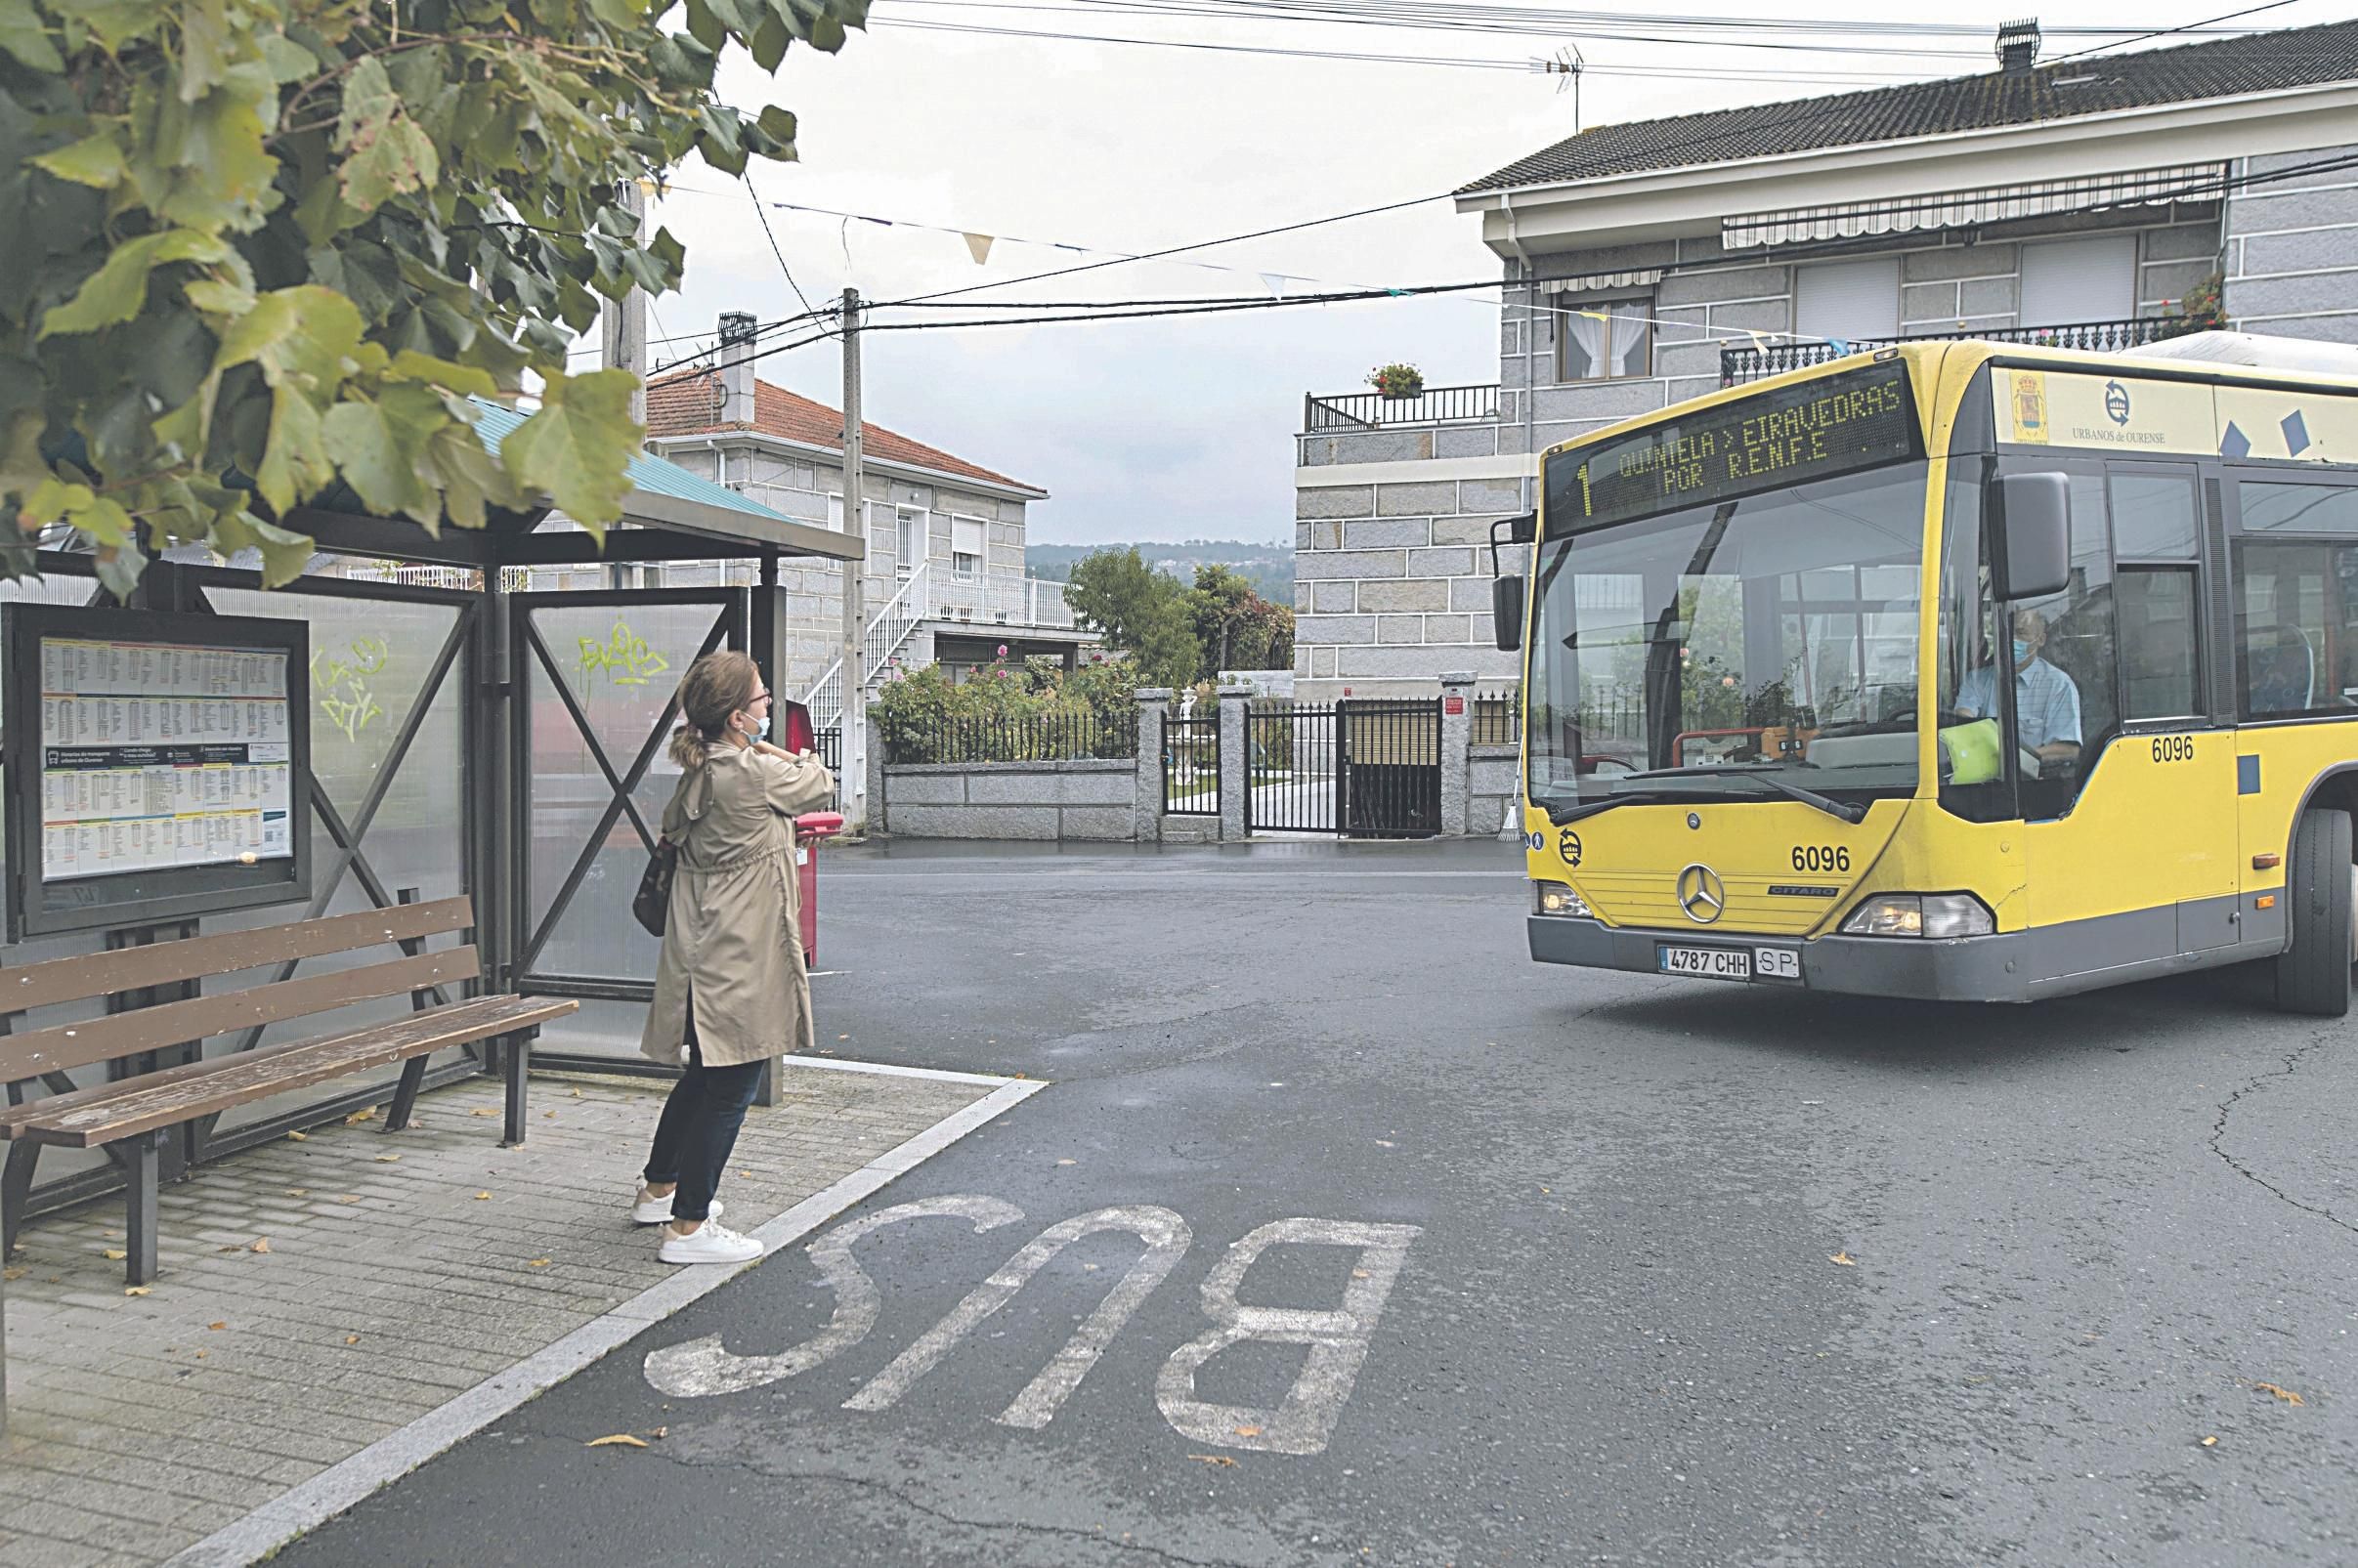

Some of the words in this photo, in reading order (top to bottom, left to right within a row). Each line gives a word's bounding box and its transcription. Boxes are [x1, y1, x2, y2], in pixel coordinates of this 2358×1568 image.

[1619, 432, 1715, 478] QUINTELA
[1742, 380, 1901, 446] EIRAVEDRAS
[2073, 428, 2115, 442] URBANOS
[2116, 432, 2125, 442] de
[2125, 432, 2165, 444] OURENSE
[1577, 464, 1592, 516] 1
[1664, 462, 1704, 494] POR
[2153, 736, 2193, 763] 6096
[1792, 846, 1850, 871] 6096
[1771, 886, 1836, 896] CITARO
[1671, 950, 1710, 971] 4787
[1715, 954, 1747, 975] CHH
[643, 1194, 1424, 1455] BUS
